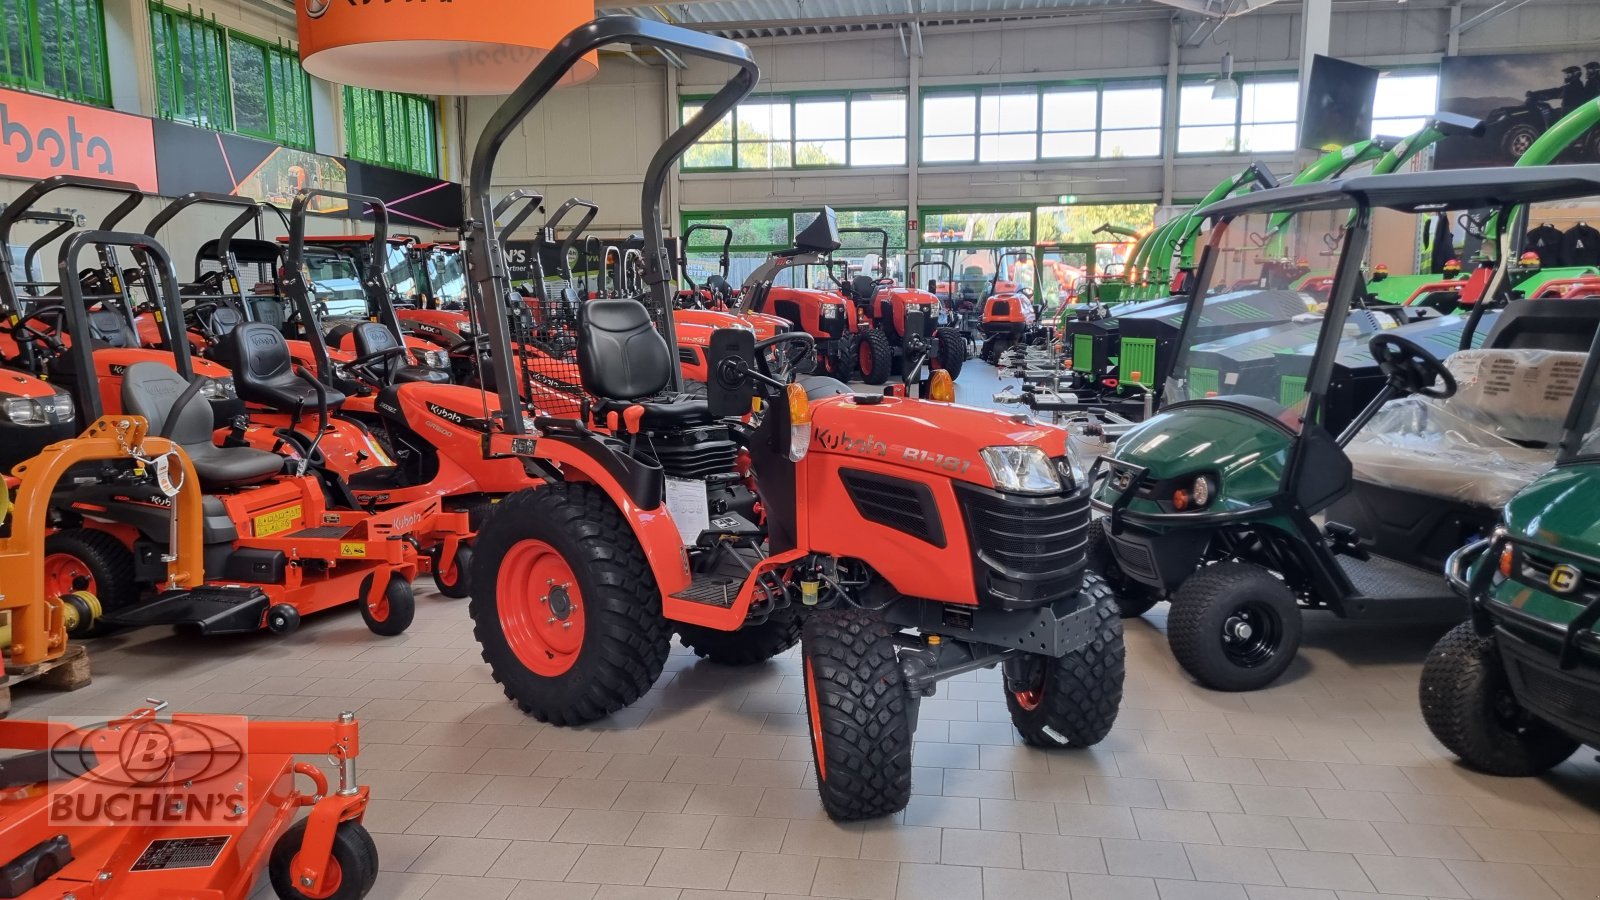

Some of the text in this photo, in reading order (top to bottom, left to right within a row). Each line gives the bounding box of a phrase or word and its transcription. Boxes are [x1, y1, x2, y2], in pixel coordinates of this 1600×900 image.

[0, 102, 114, 175] bota
[430, 404, 462, 423] Kubota
[814, 427, 887, 457] Kubota
[902, 447, 971, 474] B1-181
[150, 495, 171, 507] Kub
[393, 512, 421, 530] Kubota
